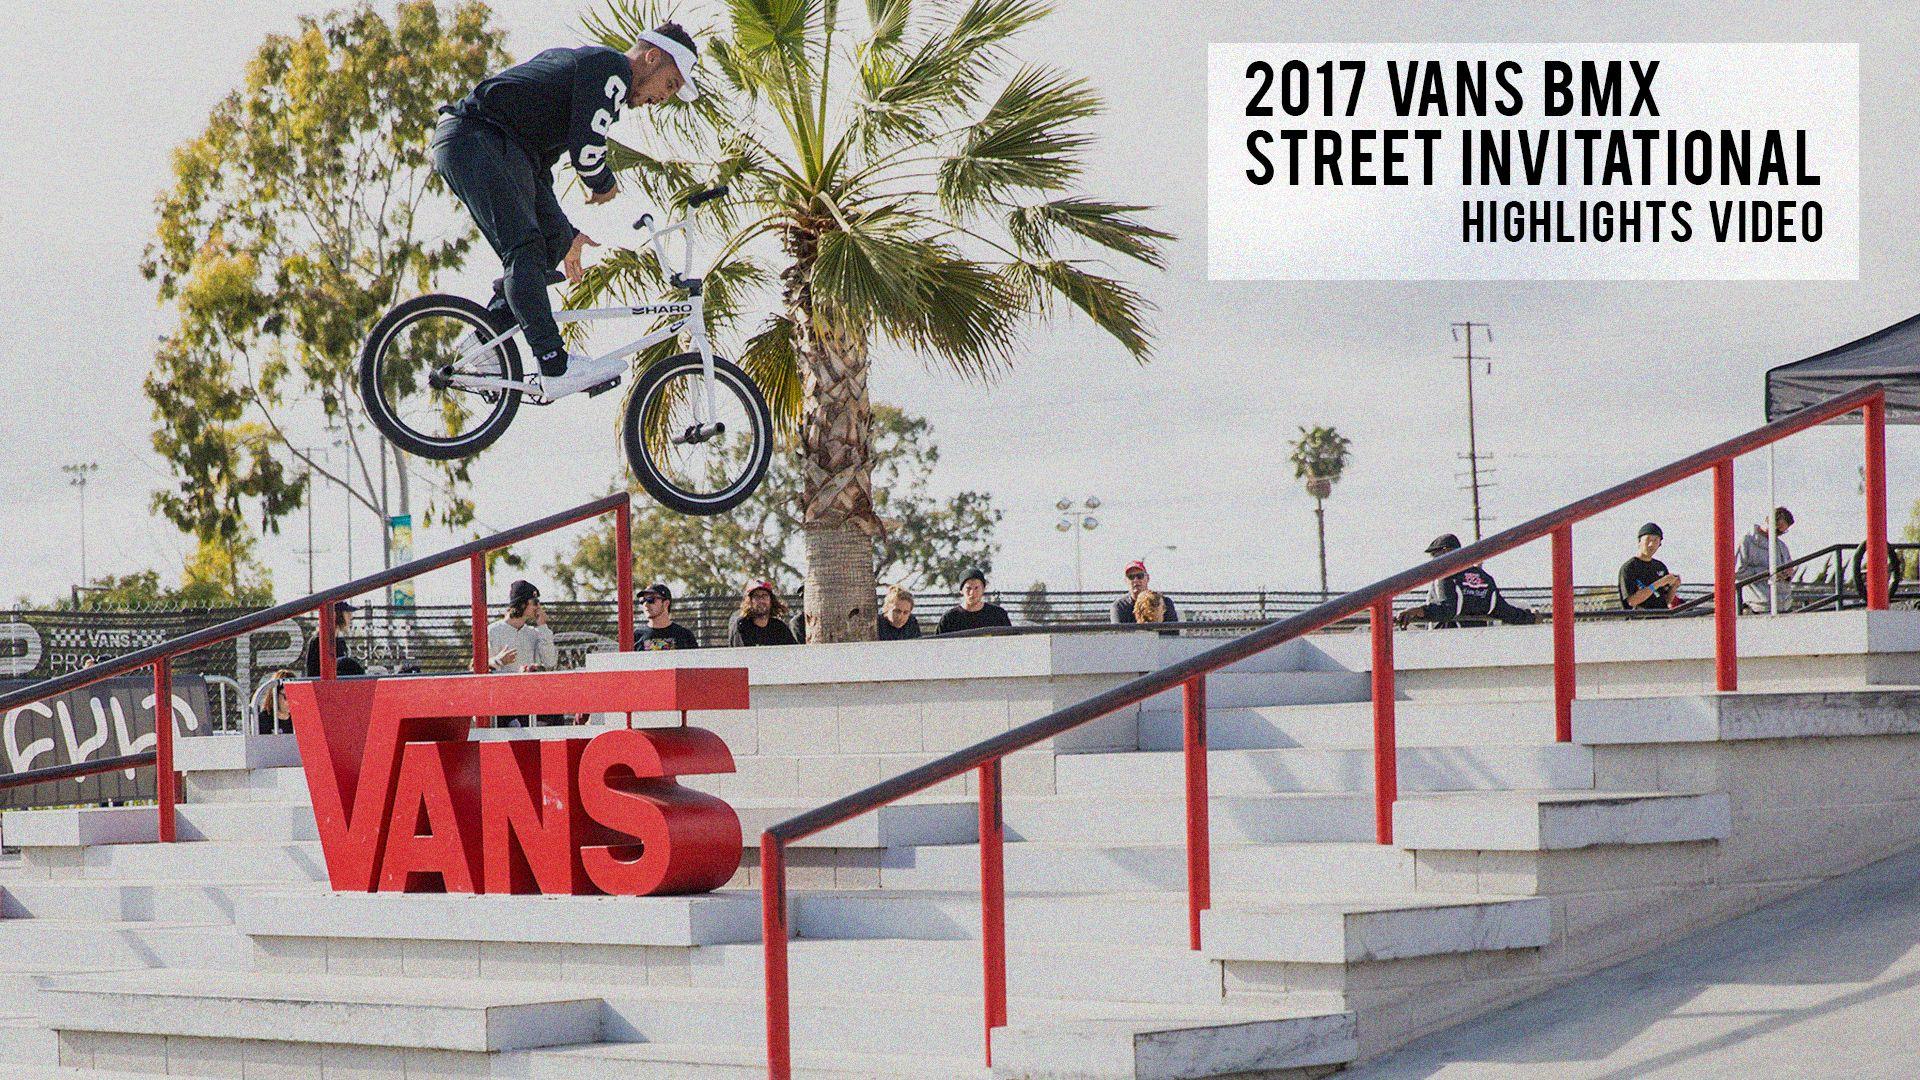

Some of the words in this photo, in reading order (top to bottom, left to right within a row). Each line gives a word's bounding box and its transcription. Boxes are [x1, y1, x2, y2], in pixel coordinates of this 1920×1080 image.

[646, 304, 692, 315] HARO
[87, 629, 131, 648] VANS
[284, 667, 749, 897] VANS
